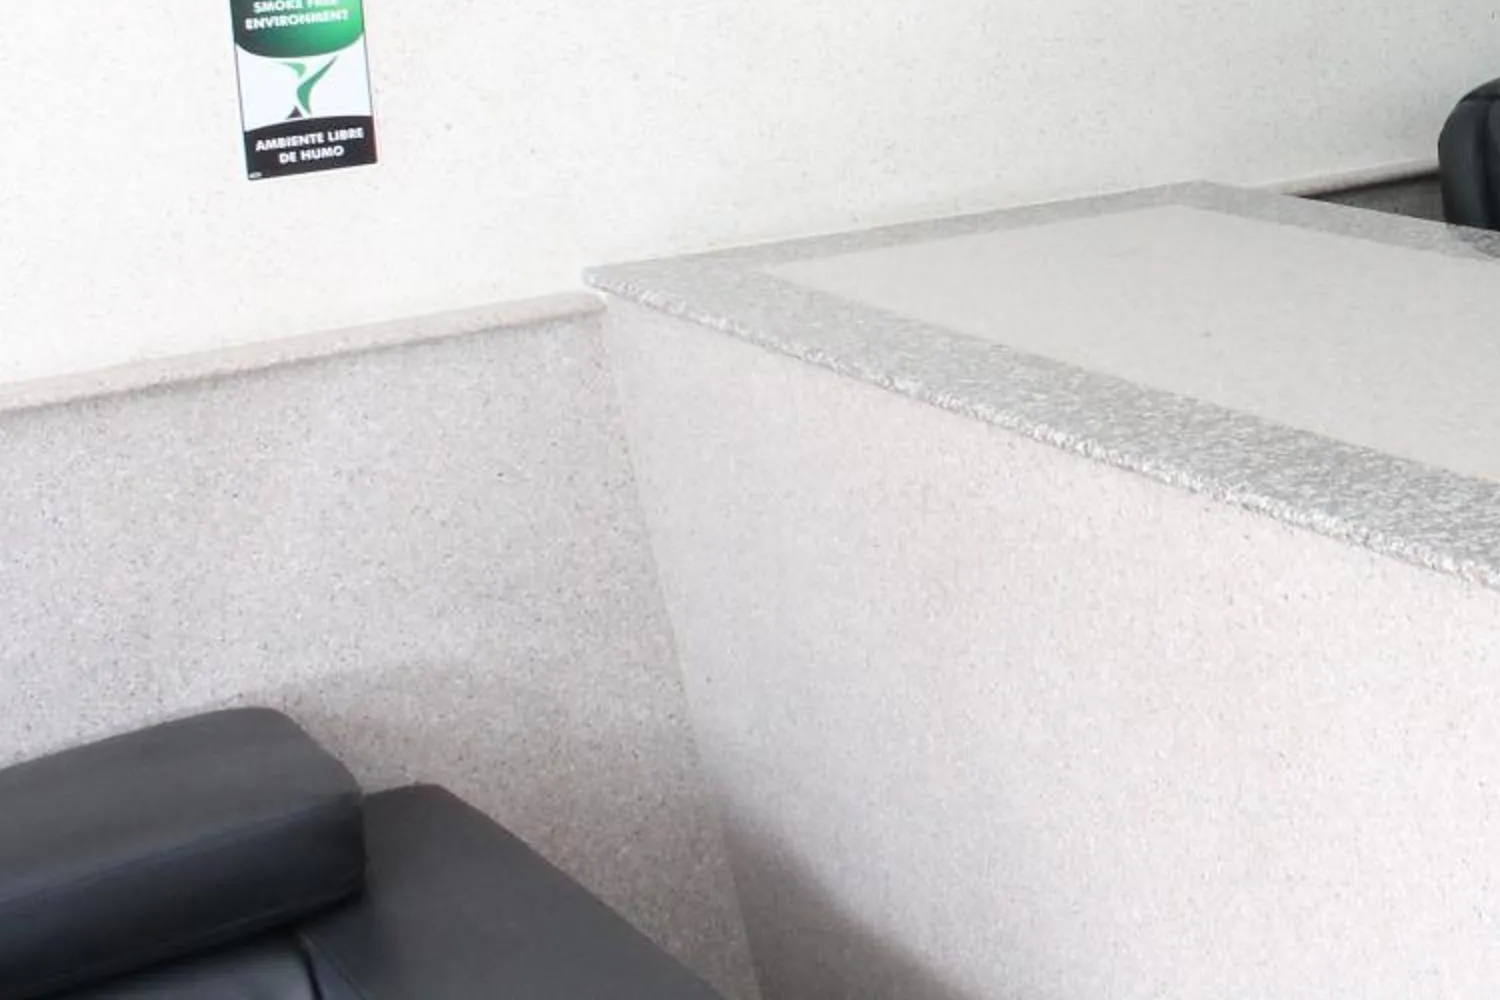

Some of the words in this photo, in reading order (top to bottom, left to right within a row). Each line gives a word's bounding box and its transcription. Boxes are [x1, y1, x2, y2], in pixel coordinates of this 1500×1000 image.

[245, 9, 349, 30] ENVIRONMENT
[255, 131, 325, 151] AMBIENTE
[328, 127, 364, 142] LIBRE
[279, 151, 298, 164] DE
[300, 145, 345, 161] HUMO
